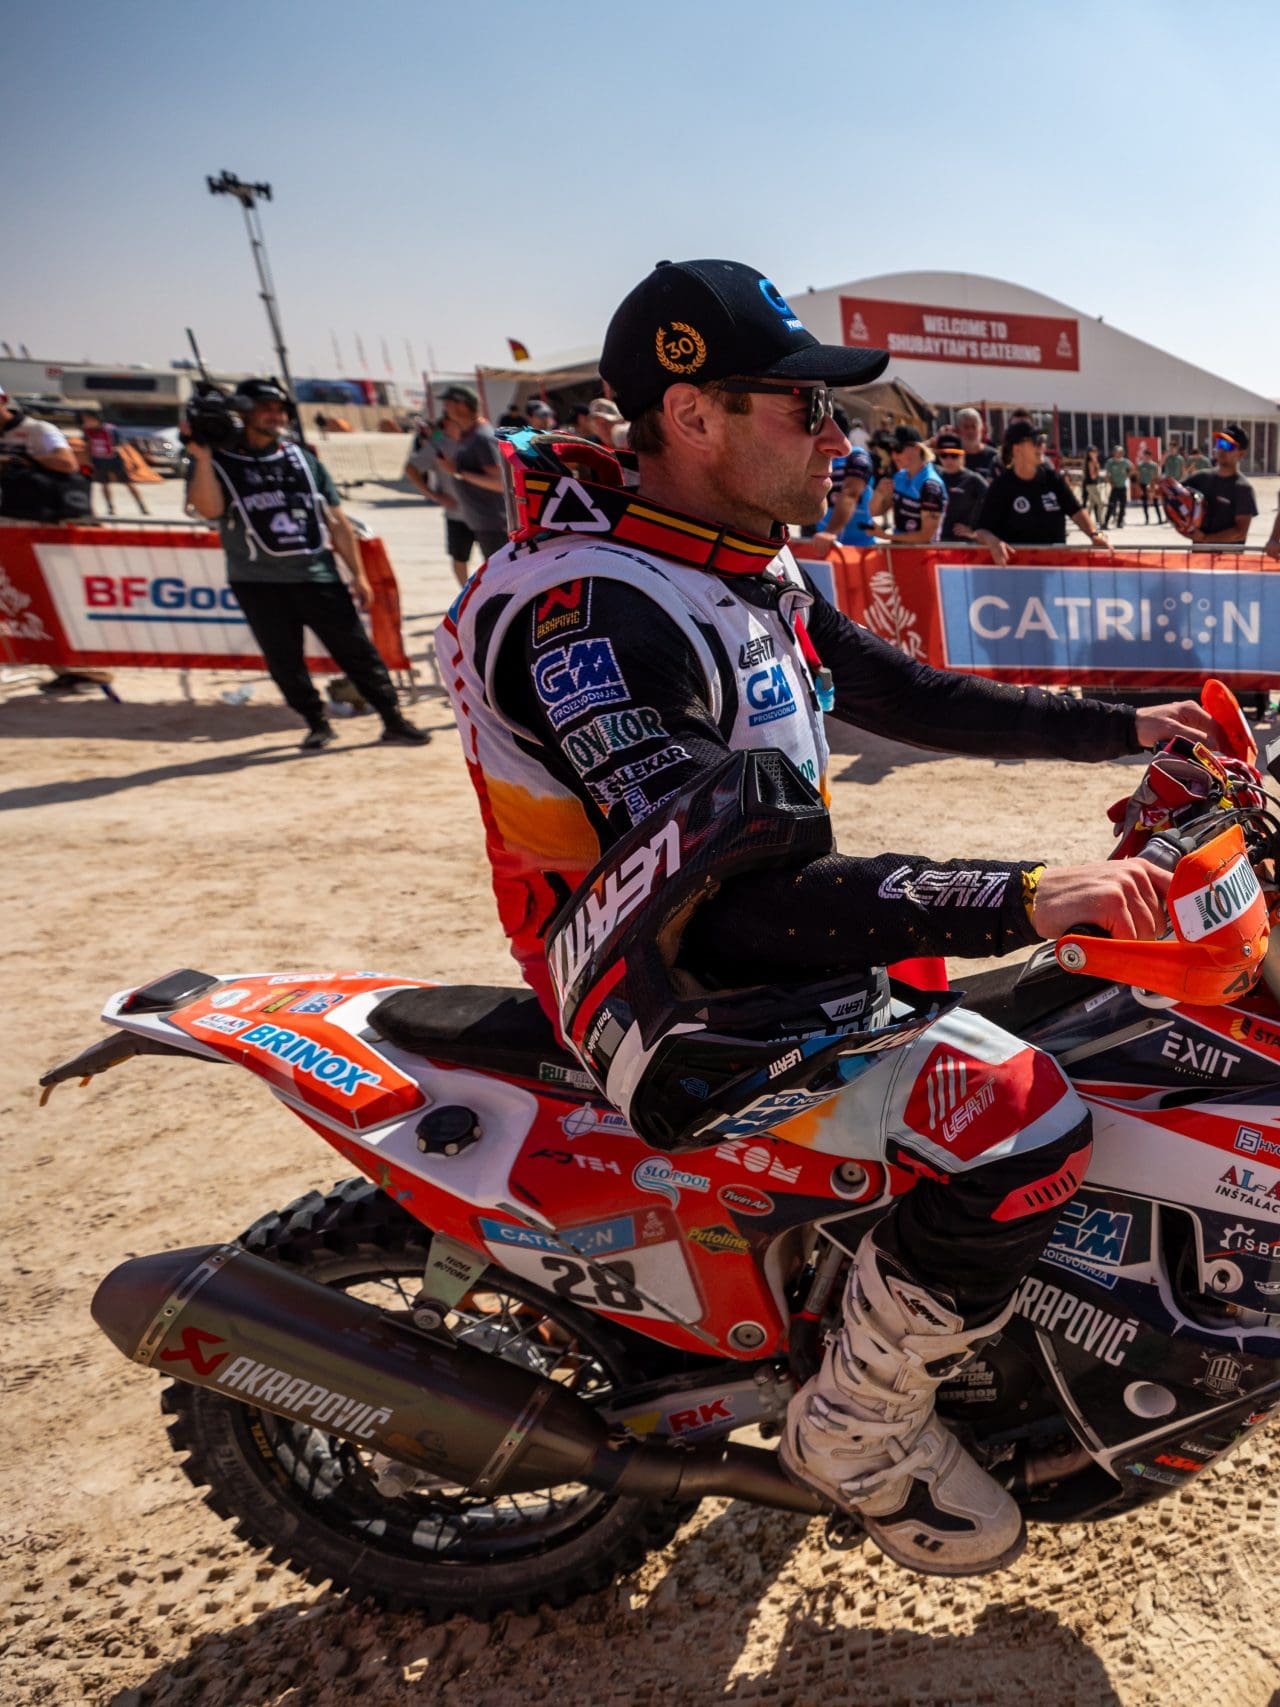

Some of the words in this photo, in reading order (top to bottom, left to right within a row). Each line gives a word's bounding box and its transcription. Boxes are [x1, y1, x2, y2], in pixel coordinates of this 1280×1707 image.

[922, 315, 988, 338] WELCOME
[990, 321, 1007, 339] TO
[665, 337, 694, 359] 30
[980, 340, 1041, 363] CATERING
[83, 575, 240, 610] BFGoo
[552, 687, 620, 721] PROIZVODNJA
[877, 864, 1012, 909] LEATT
[241, 1025, 364, 1094] BRINOX
[642, 1164, 671, 1181] SLO
[671, 1170, 711, 1189] POOL
[687, 1227, 751, 1253] Putoline
[541, 1255, 644, 1312] 28
[216, 1355, 395, 1440] AKRAPOVIČ
[669, 1398, 732, 1433] RK
